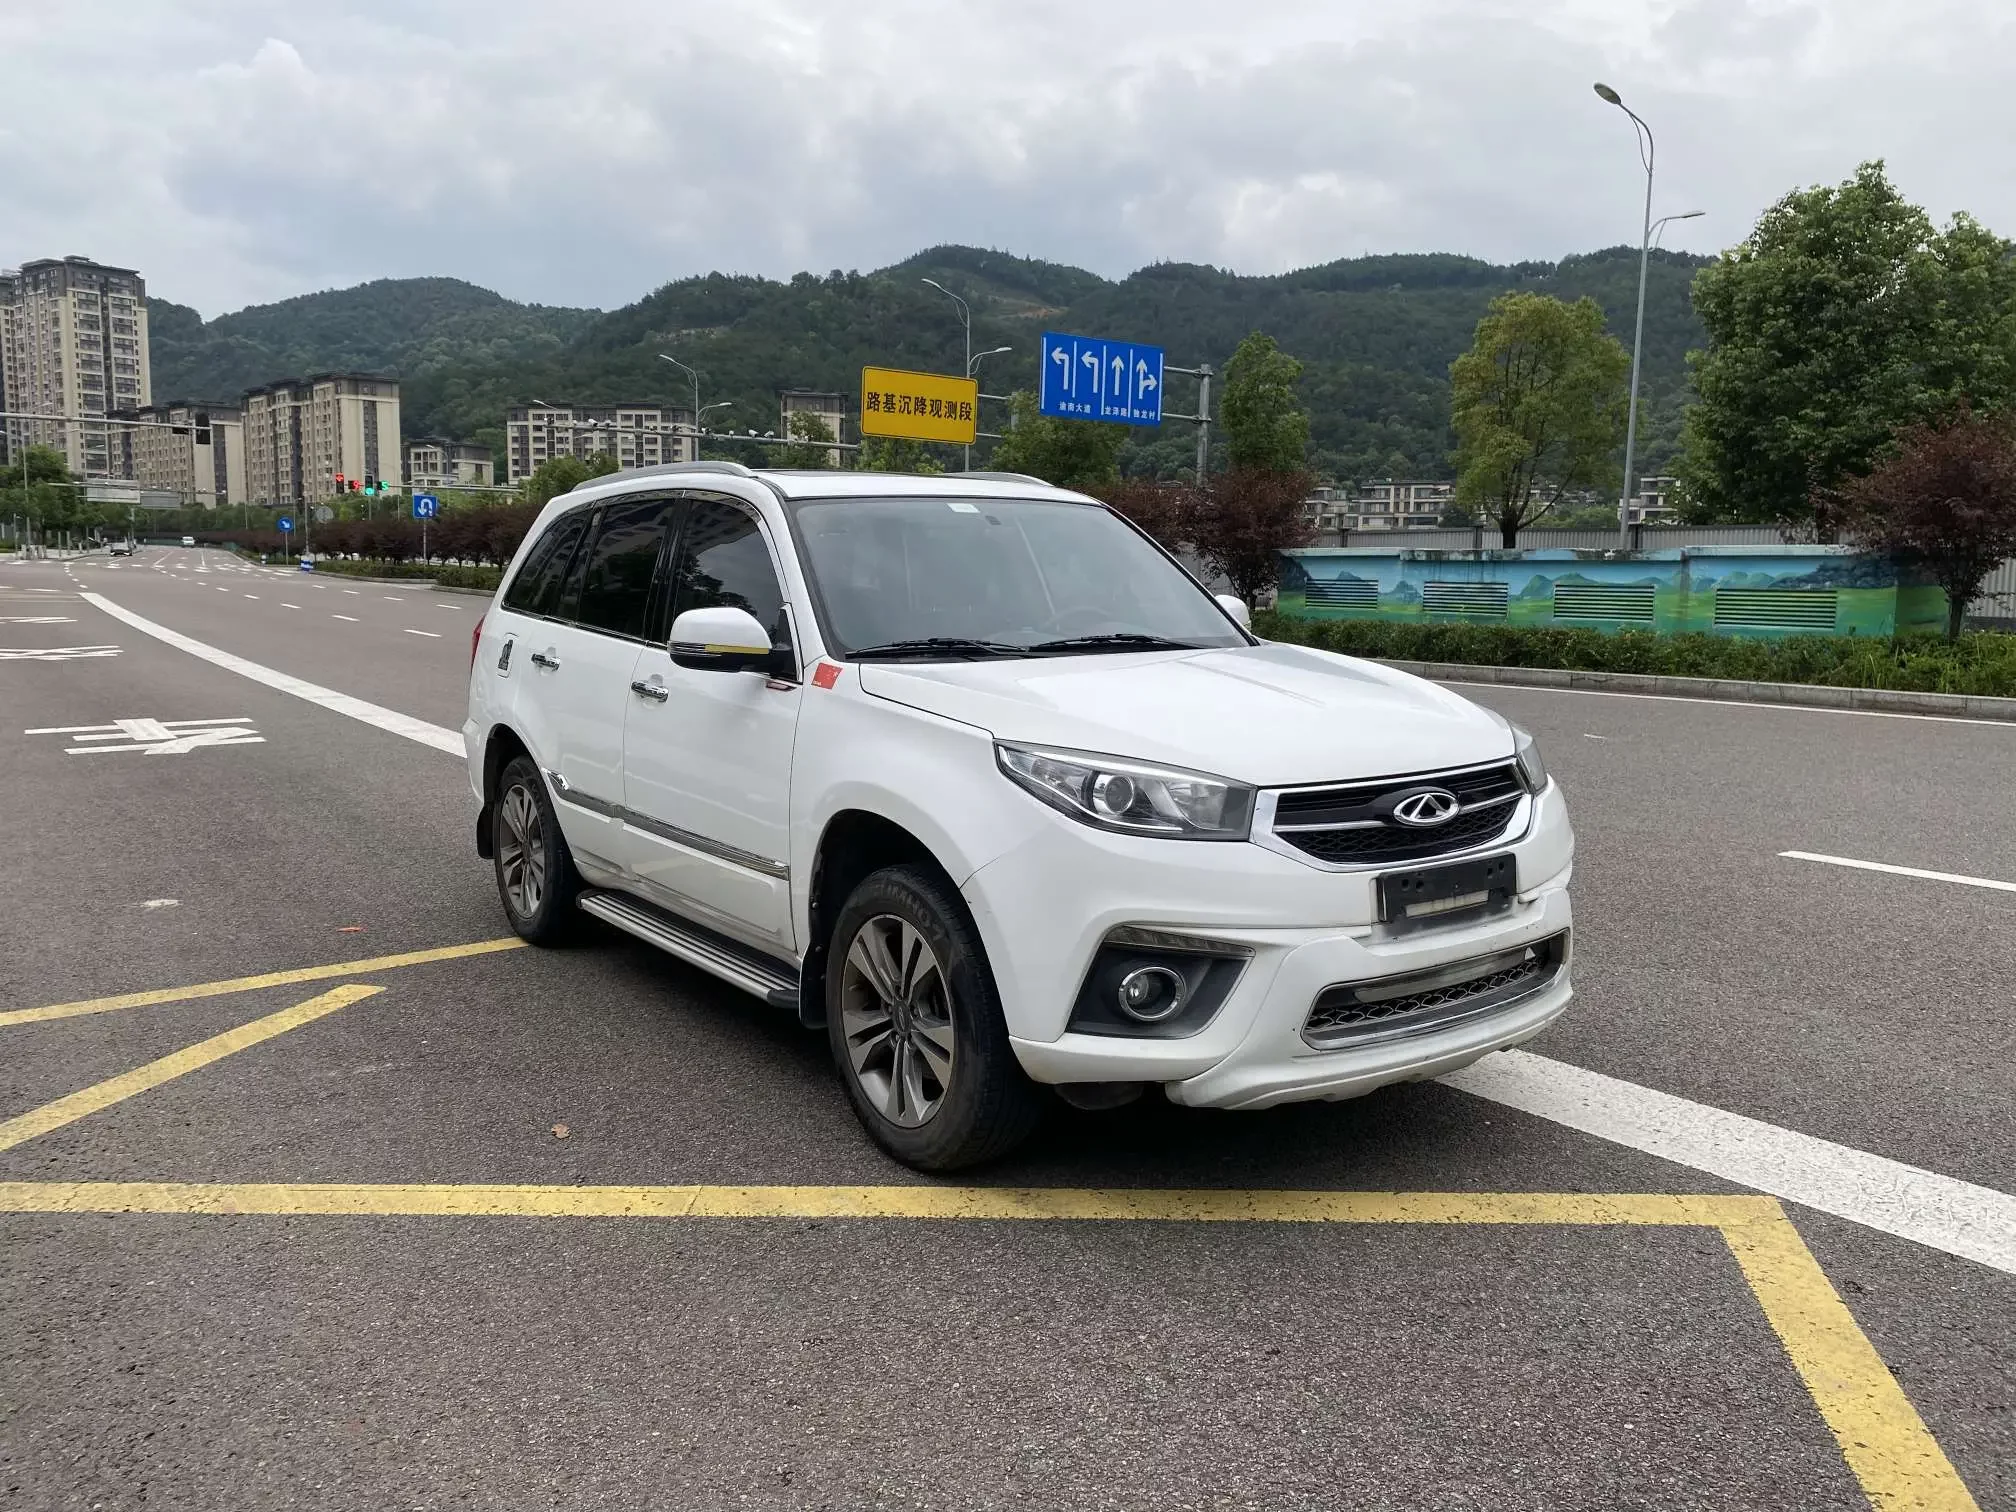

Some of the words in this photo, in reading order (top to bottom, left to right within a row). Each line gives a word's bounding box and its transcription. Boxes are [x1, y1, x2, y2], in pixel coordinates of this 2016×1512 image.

[866, 391, 972, 421] 路基沉降观测段
[381, 480, 389, 491] 5
